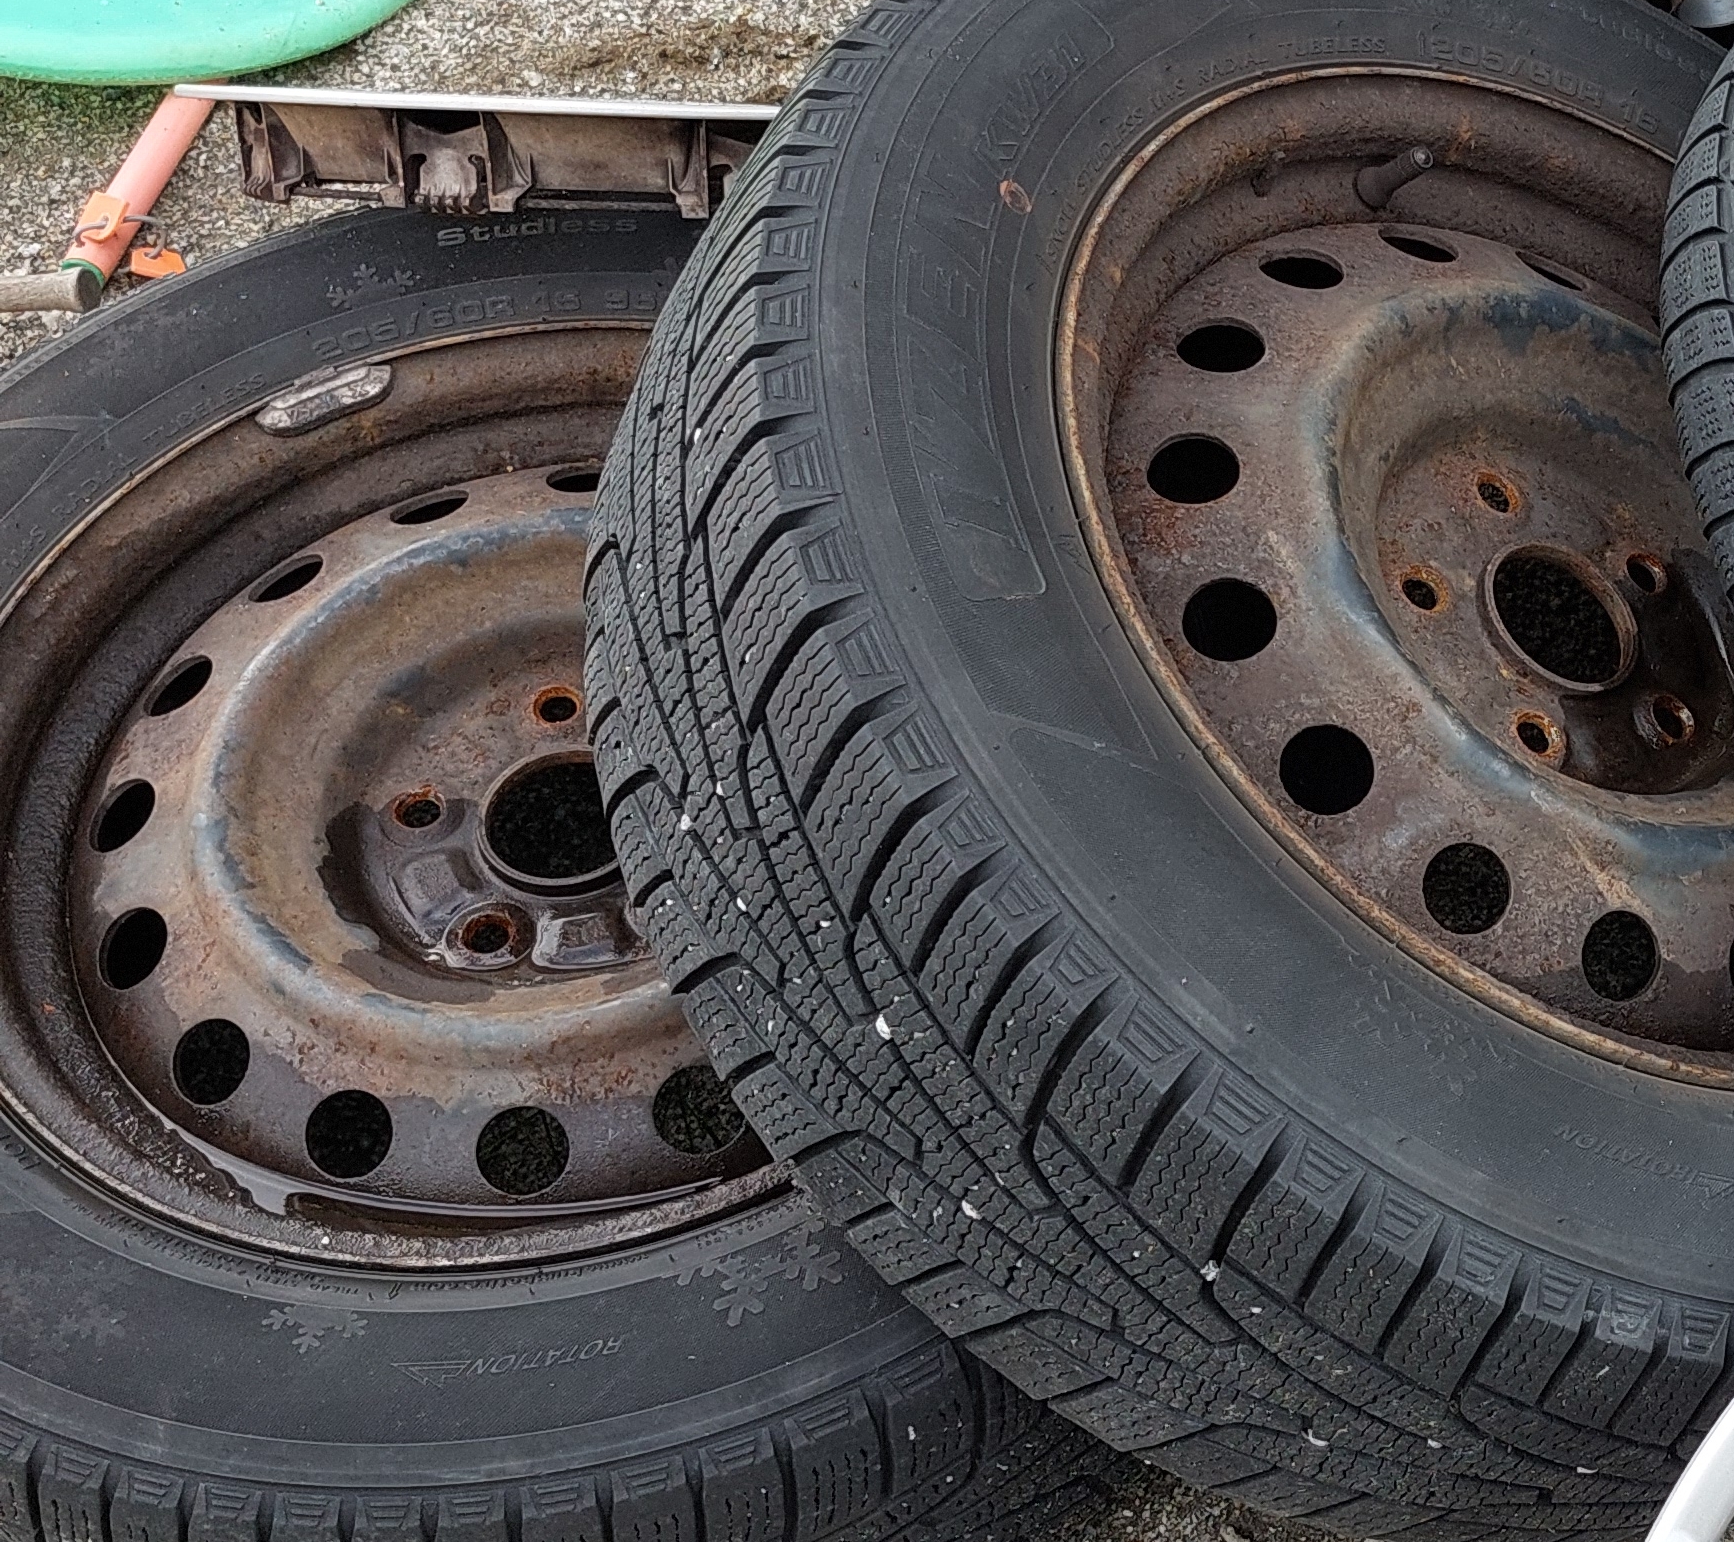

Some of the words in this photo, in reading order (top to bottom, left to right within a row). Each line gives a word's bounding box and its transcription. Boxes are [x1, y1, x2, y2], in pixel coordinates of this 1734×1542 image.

[1197, 54, 1269, 88] RADIAL
[1278, 36, 1387, 62] TUBELESS
[1431, 38, 1602, 107] 205/60R
[436, 216, 639, 248] Studless
[312, 295, 516, 359] 205/60R
[1551, 1124, 1697, 1184] ROTATION
[465, 1334, 625, 1377] ROTATION
